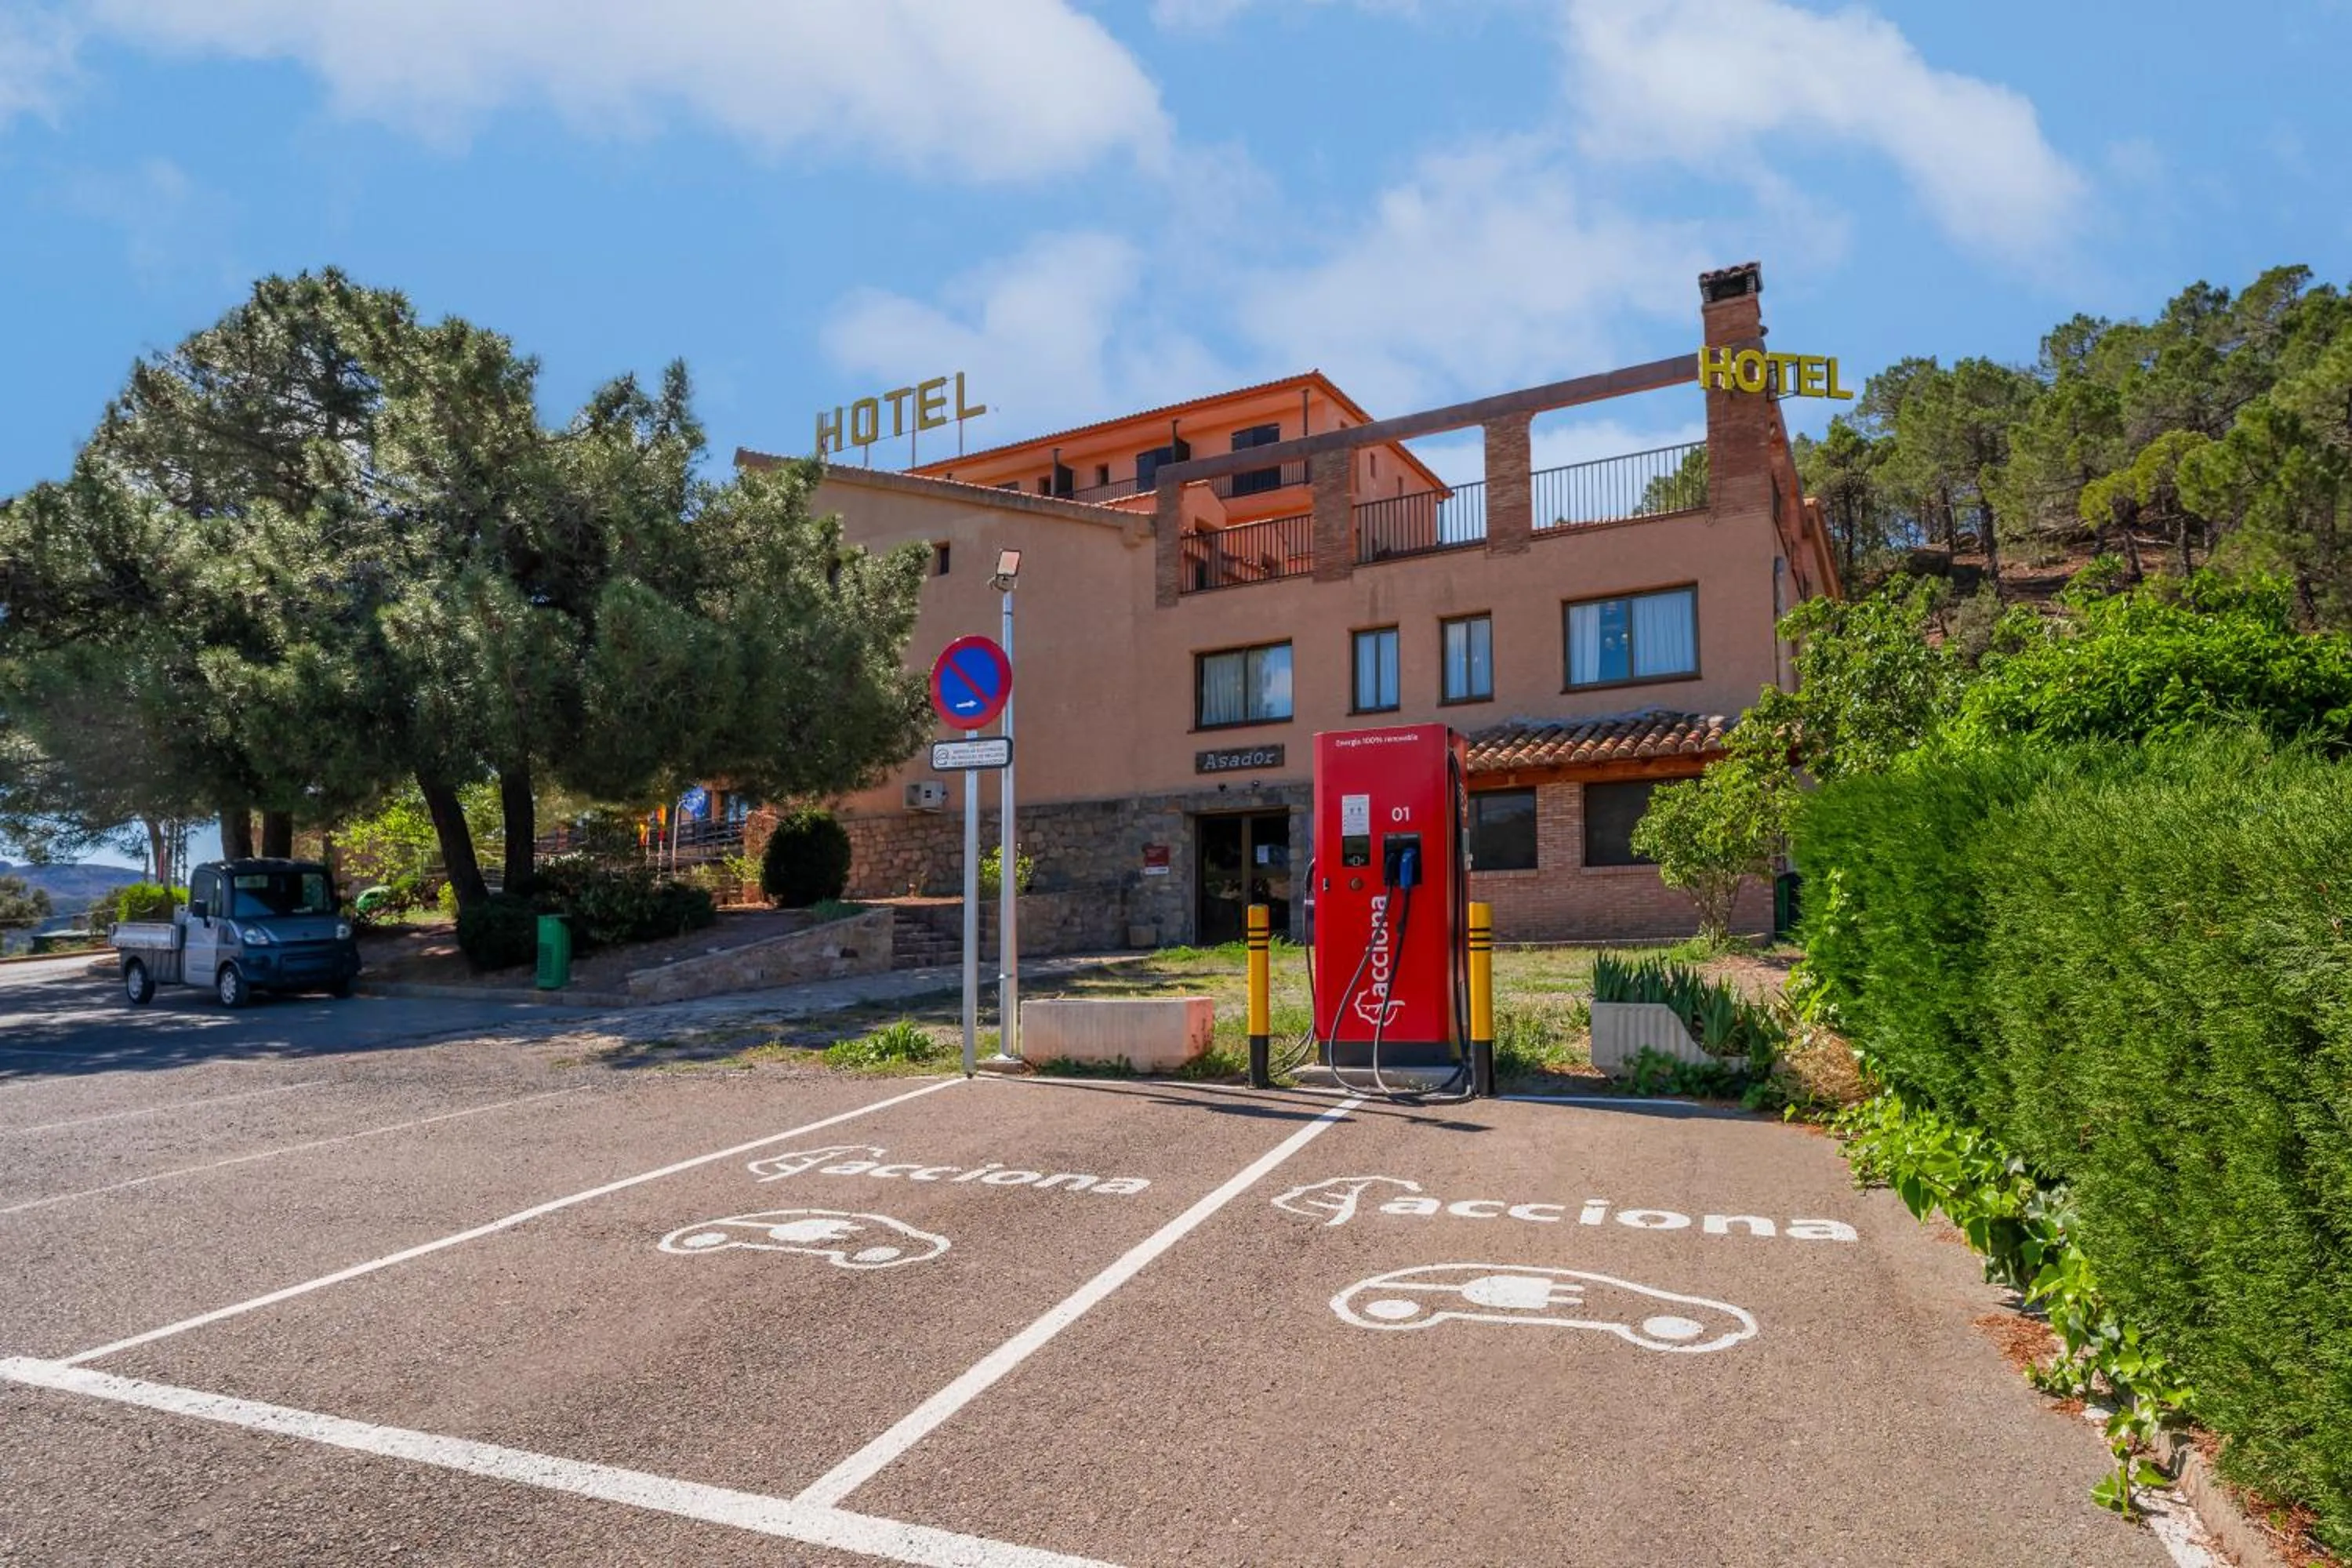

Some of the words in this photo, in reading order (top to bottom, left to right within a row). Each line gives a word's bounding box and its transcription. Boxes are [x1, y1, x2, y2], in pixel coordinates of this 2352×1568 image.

[1698, 346, 1854, 399] HOTEL
[816, 372, 986, 453] HOTEL
[1203, 752, 1275, 769] Asador
[1392, 806, 1410, 822] 01
[1366, 896, 1388, 997] acciona
[820, 1160, 1152, 1194] acciona
[1379, 1196, 1858, 1241] acciona
